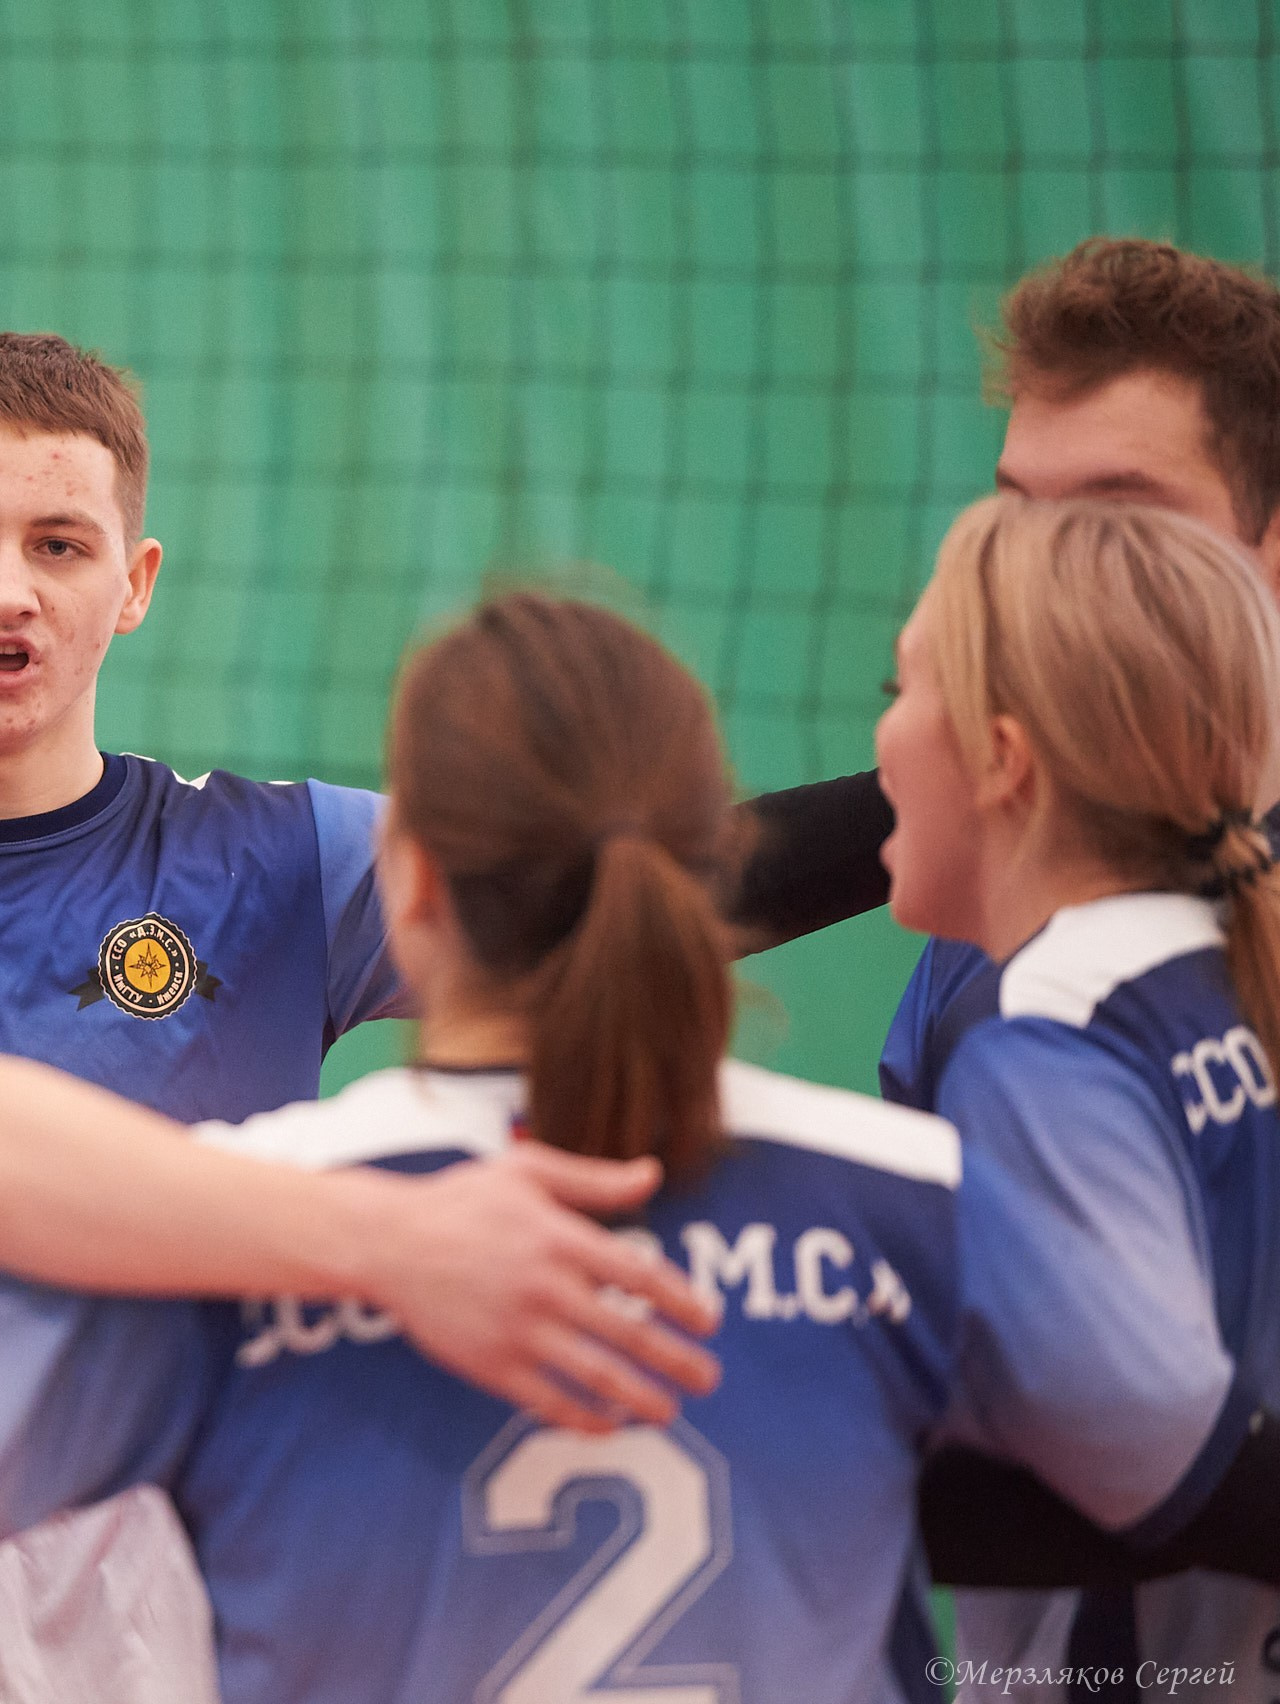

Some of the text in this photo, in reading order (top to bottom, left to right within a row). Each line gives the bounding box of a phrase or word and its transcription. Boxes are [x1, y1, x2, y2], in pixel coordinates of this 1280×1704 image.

[111, 938, 128, 961] ССО
[113, 971, 184, 1006] ИжГТУ Ижевск
[461, 1413, 741, 1704] 2
